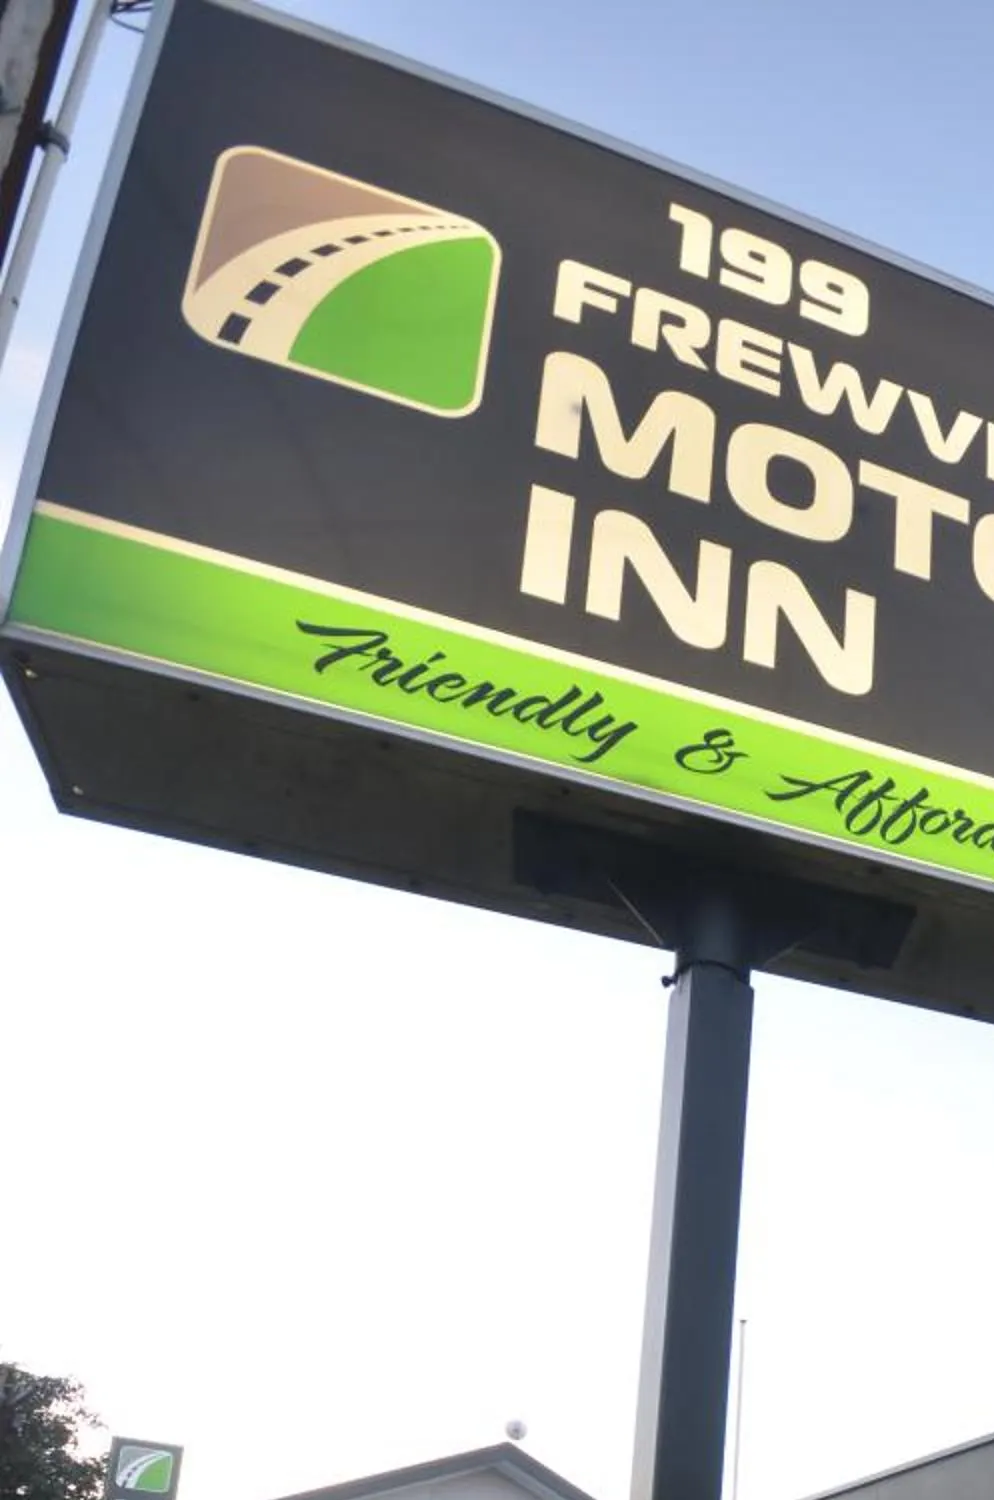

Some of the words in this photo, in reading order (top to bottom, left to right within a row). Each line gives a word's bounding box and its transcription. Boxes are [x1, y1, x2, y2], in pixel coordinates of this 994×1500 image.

[669, 203, 869, 337] 199
[520, 484, 876, 696] INN
[296, 619, 638, 763] Friendly
[674, 728, 749, 774] &
